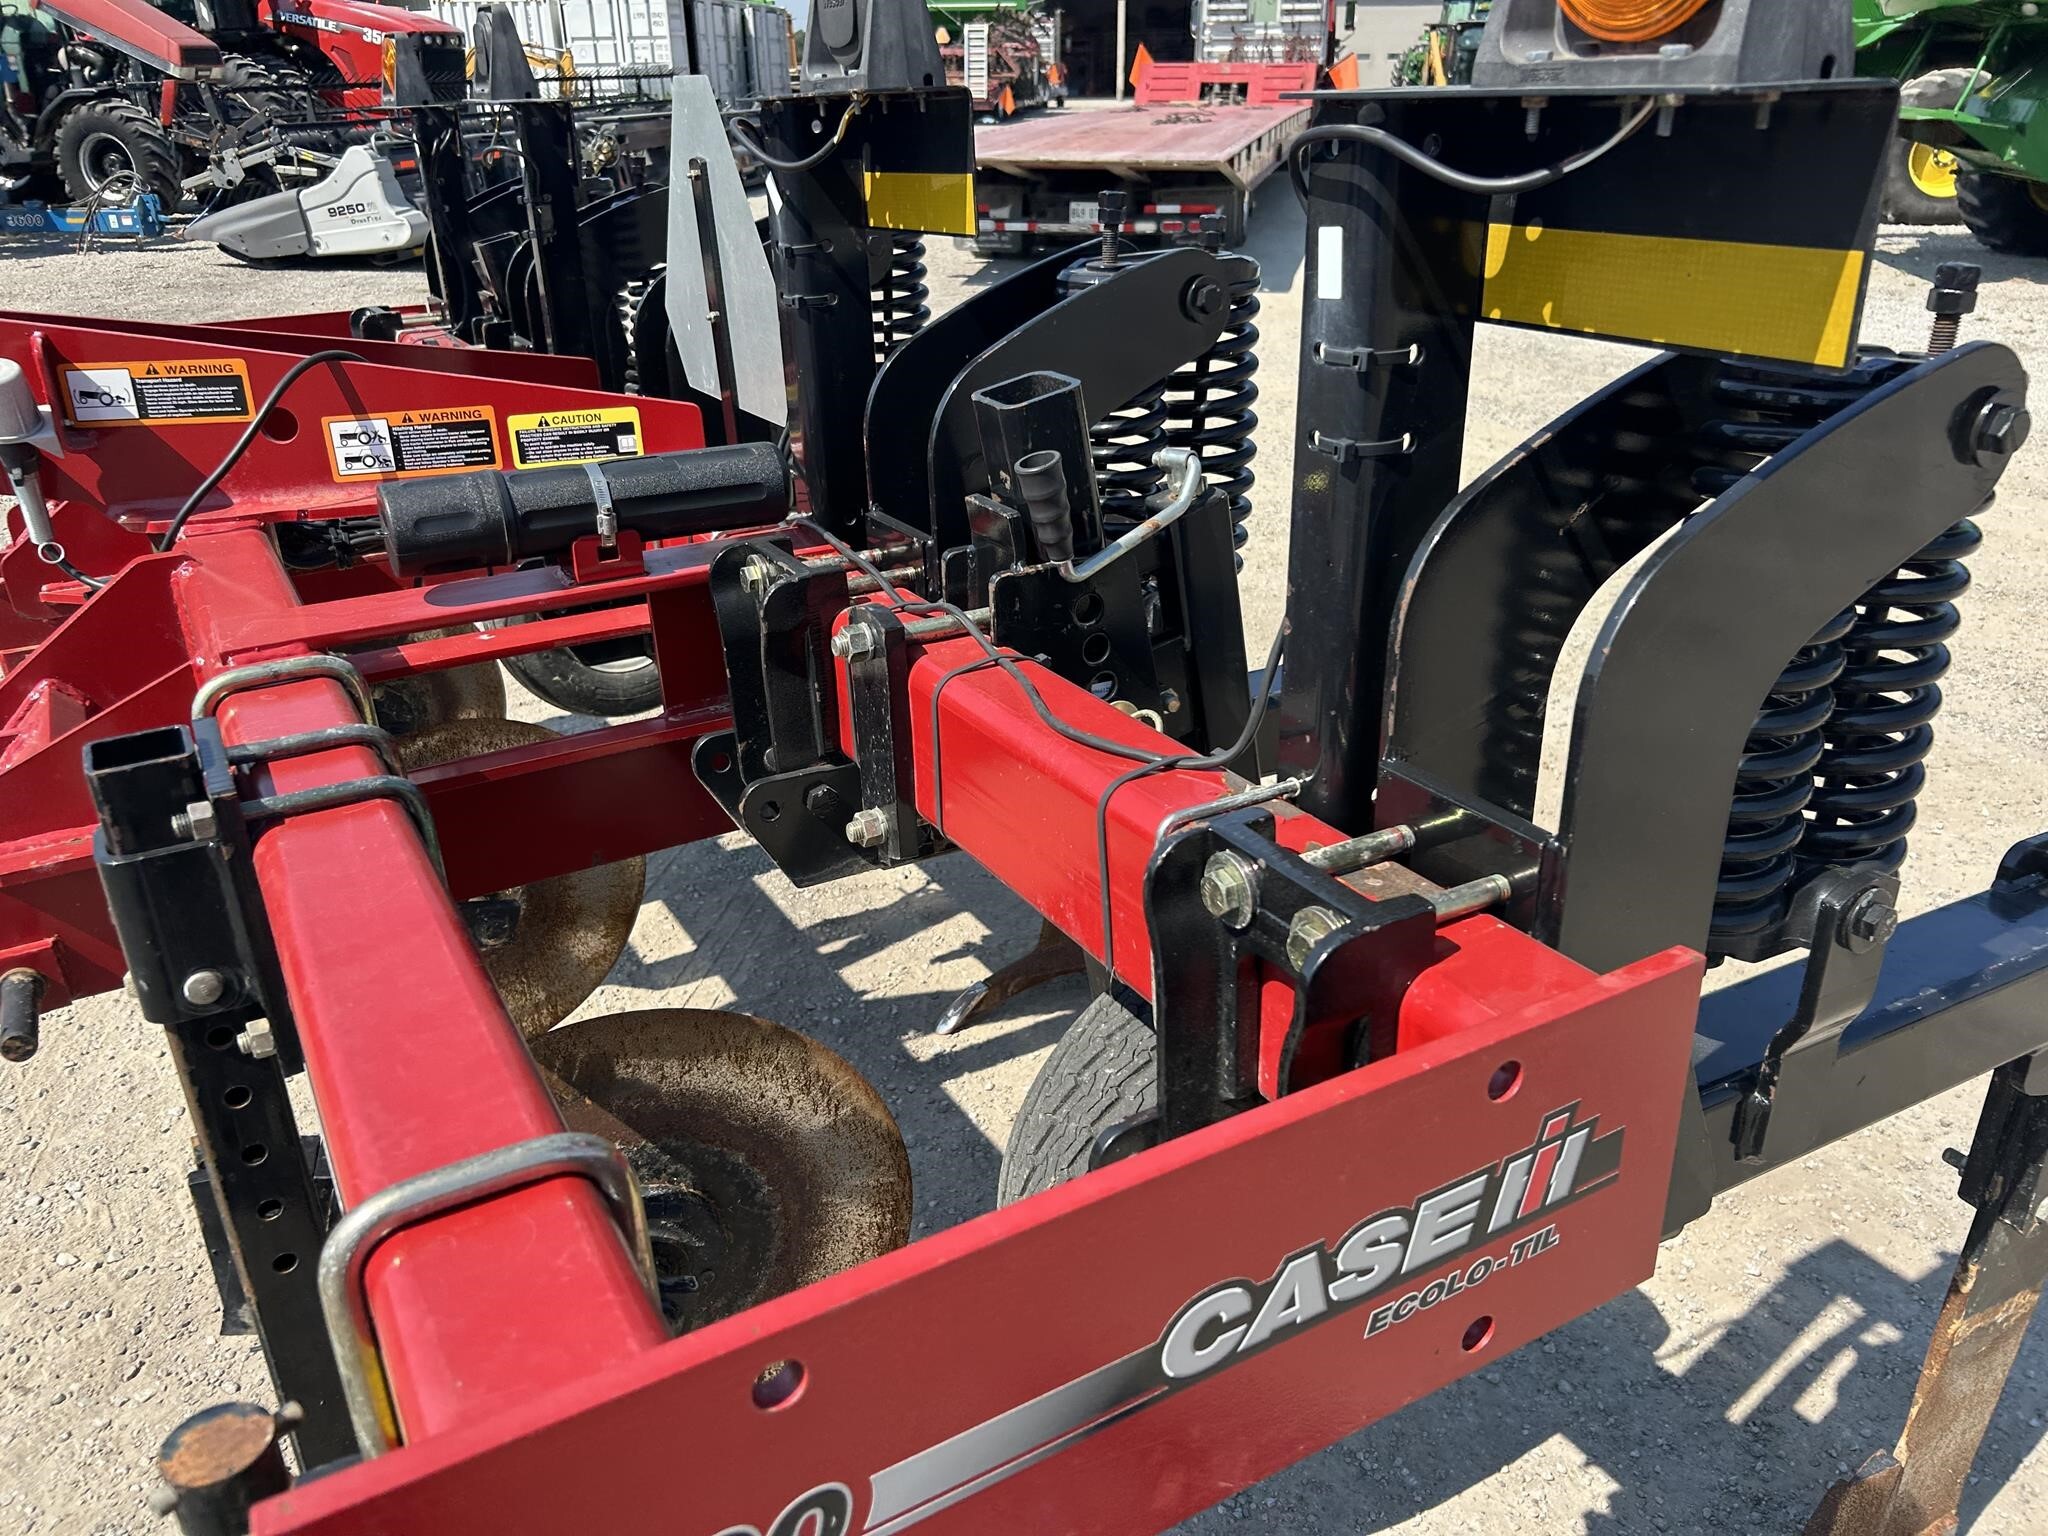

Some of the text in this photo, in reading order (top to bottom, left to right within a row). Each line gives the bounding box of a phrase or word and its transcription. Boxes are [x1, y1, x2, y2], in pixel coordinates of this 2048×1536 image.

[280, 11, 337, 32] VERSATILE
[327, 203, 366, 218] 9250
[164, 363, 234, 375] WARNING
[419, 409, 482, 423] WARNING
[552, 413, 602, 425] CAUTION
[1161, 1174, 1489, 1378] CASE
[1363, 1223, 1561, 1340] ECOLO-TIL
